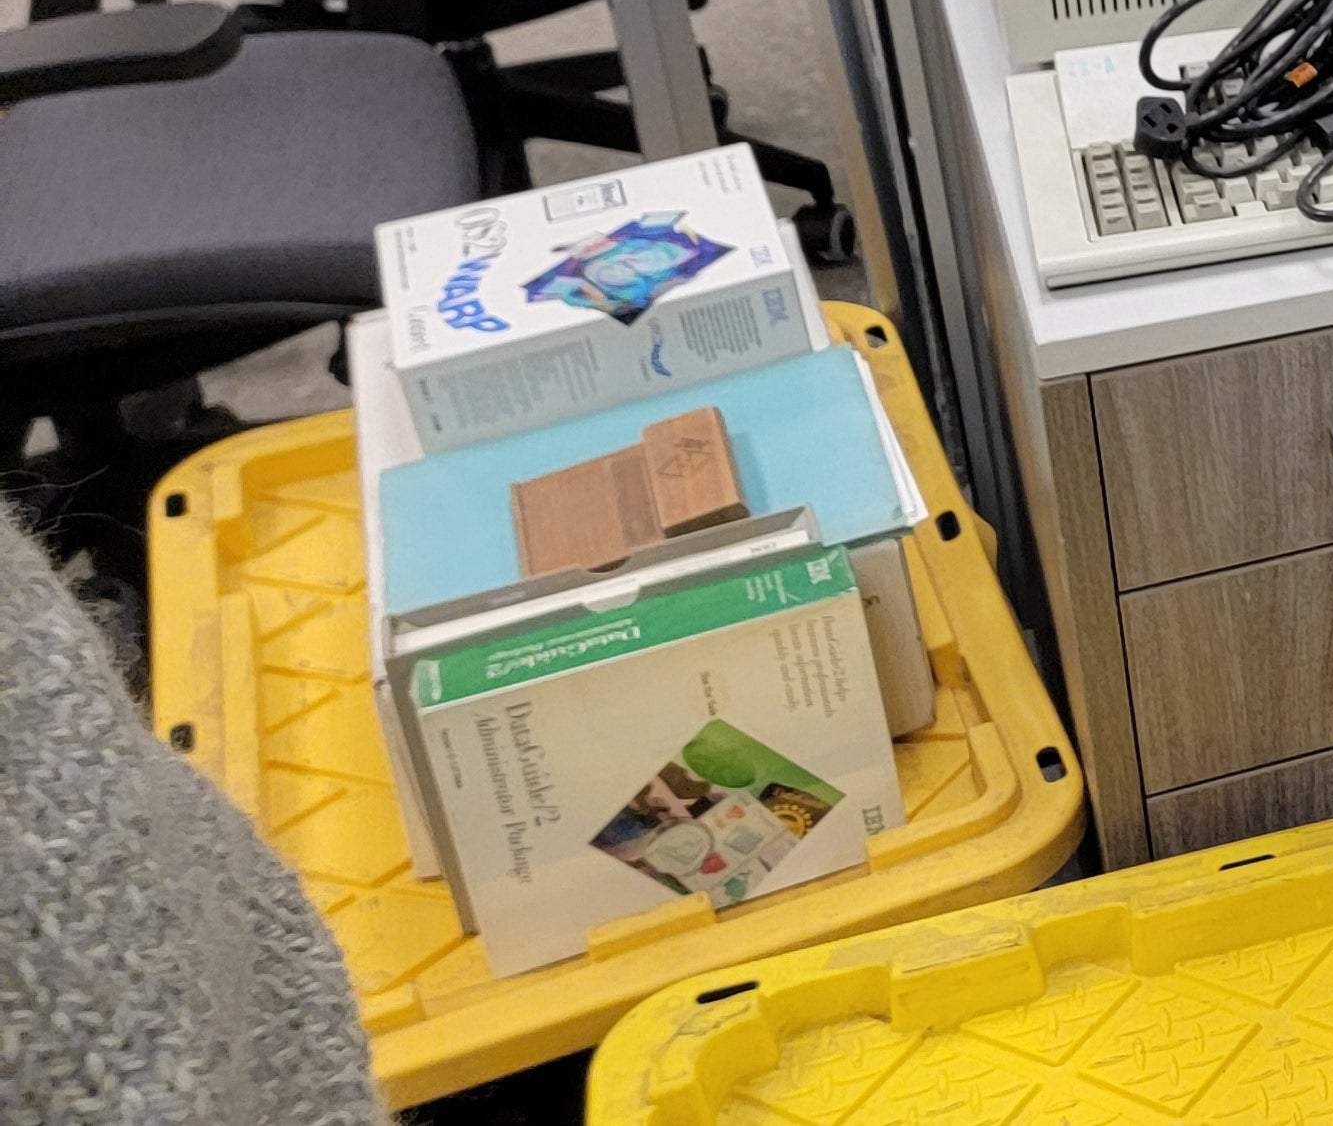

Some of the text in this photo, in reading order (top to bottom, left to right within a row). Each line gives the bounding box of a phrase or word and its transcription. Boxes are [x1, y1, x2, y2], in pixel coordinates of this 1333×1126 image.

[437, 251, 511, 333] WARP
[474, 712, 532, 884] Administrator Package
[504, 701, 562, 827] DataGuide/2
